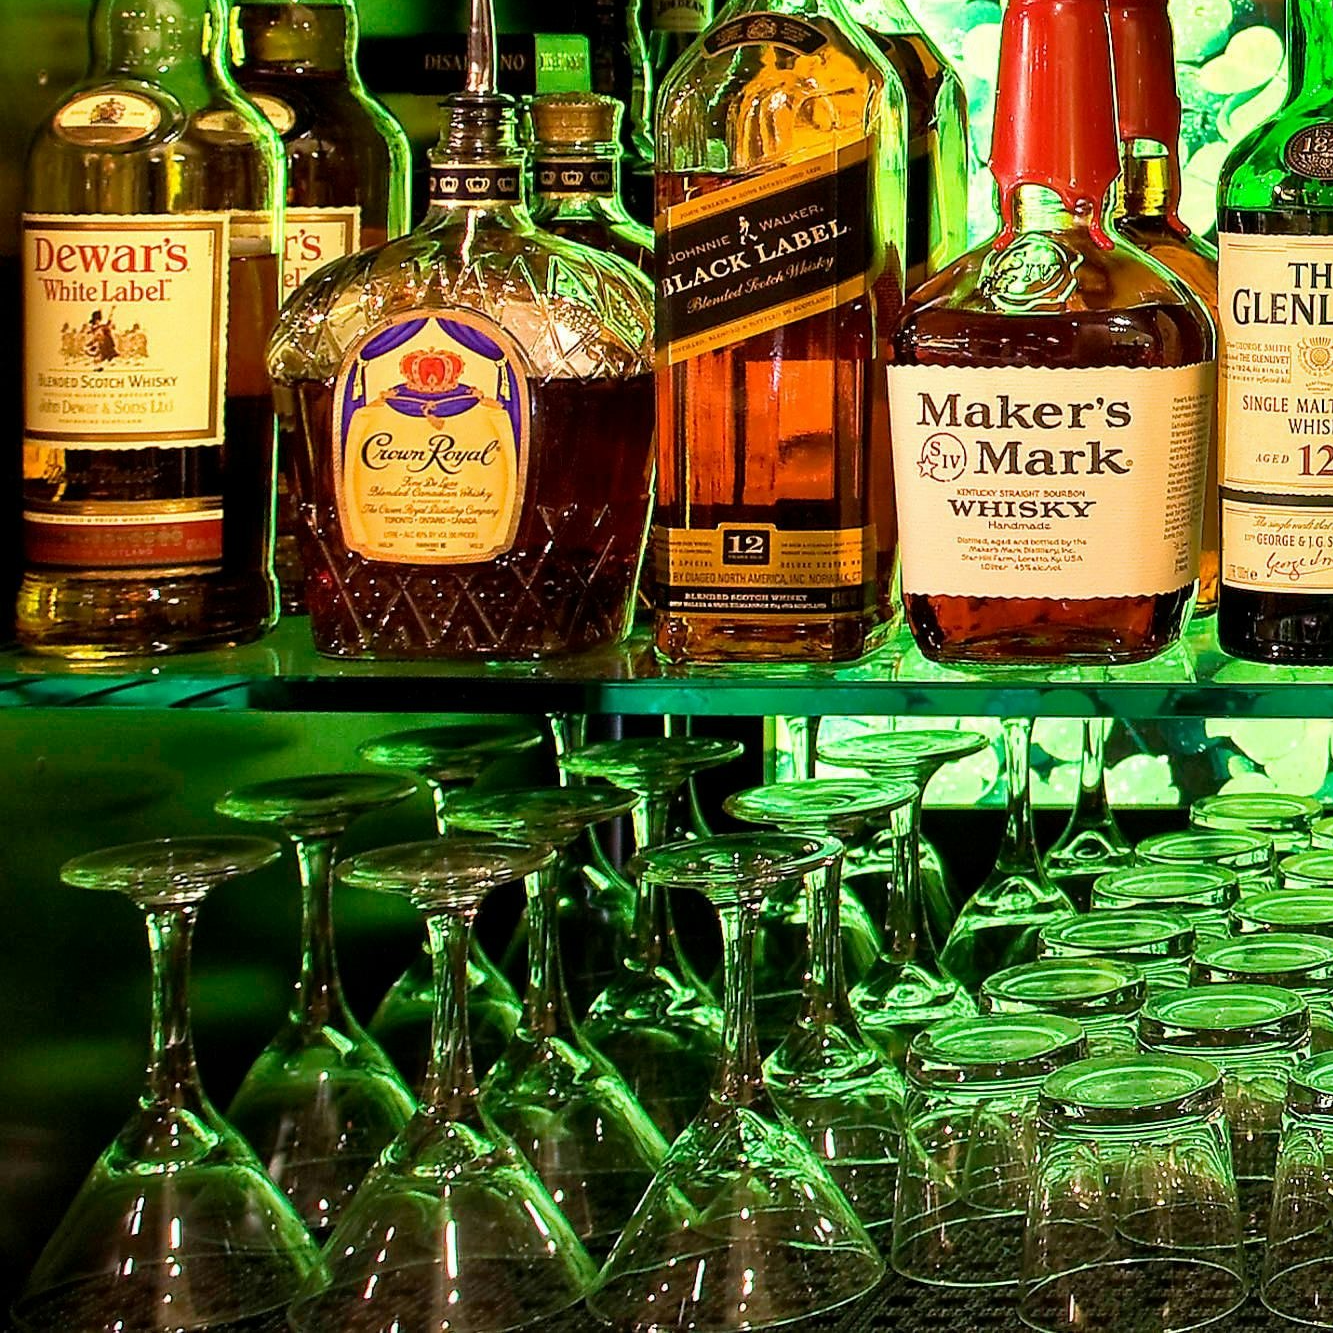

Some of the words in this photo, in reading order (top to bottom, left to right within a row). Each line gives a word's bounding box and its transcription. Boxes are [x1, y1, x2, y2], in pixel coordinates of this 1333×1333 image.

[34, 237, 188, 274] Dewar's
[662, 251, 751, 298] BLACK
[754, 219, 847, 263] LABEL
[668, 235, 731, 265] JOHNNIE
[687, 284, 743, 314] Blended
[744, 271, 784, 294] Scotch
[785, 256, 835, 280] Whisky
[81, 375, 125, 389] SCOTCH
[128, 375, 178, 388] WHISKY
[917, 393, 1132, 430] Maker's
[1242, 394, 1289, 413] SINGLE
[361, 433, 425, 470] Crown
[407, 434, 499, 475] Royal
[973, 440, 1130, 476] Mark
[1256, 453, 1290, 464] AGED
[1000, 489, 1040, 497] STRAIGHT
[947, 499, 1097, 518] WHISKY
[988, 521, 1052, 530] Handmade
[727, 536, 764, 554] 12
[1257, 535, 1295, 546] GEORGE
